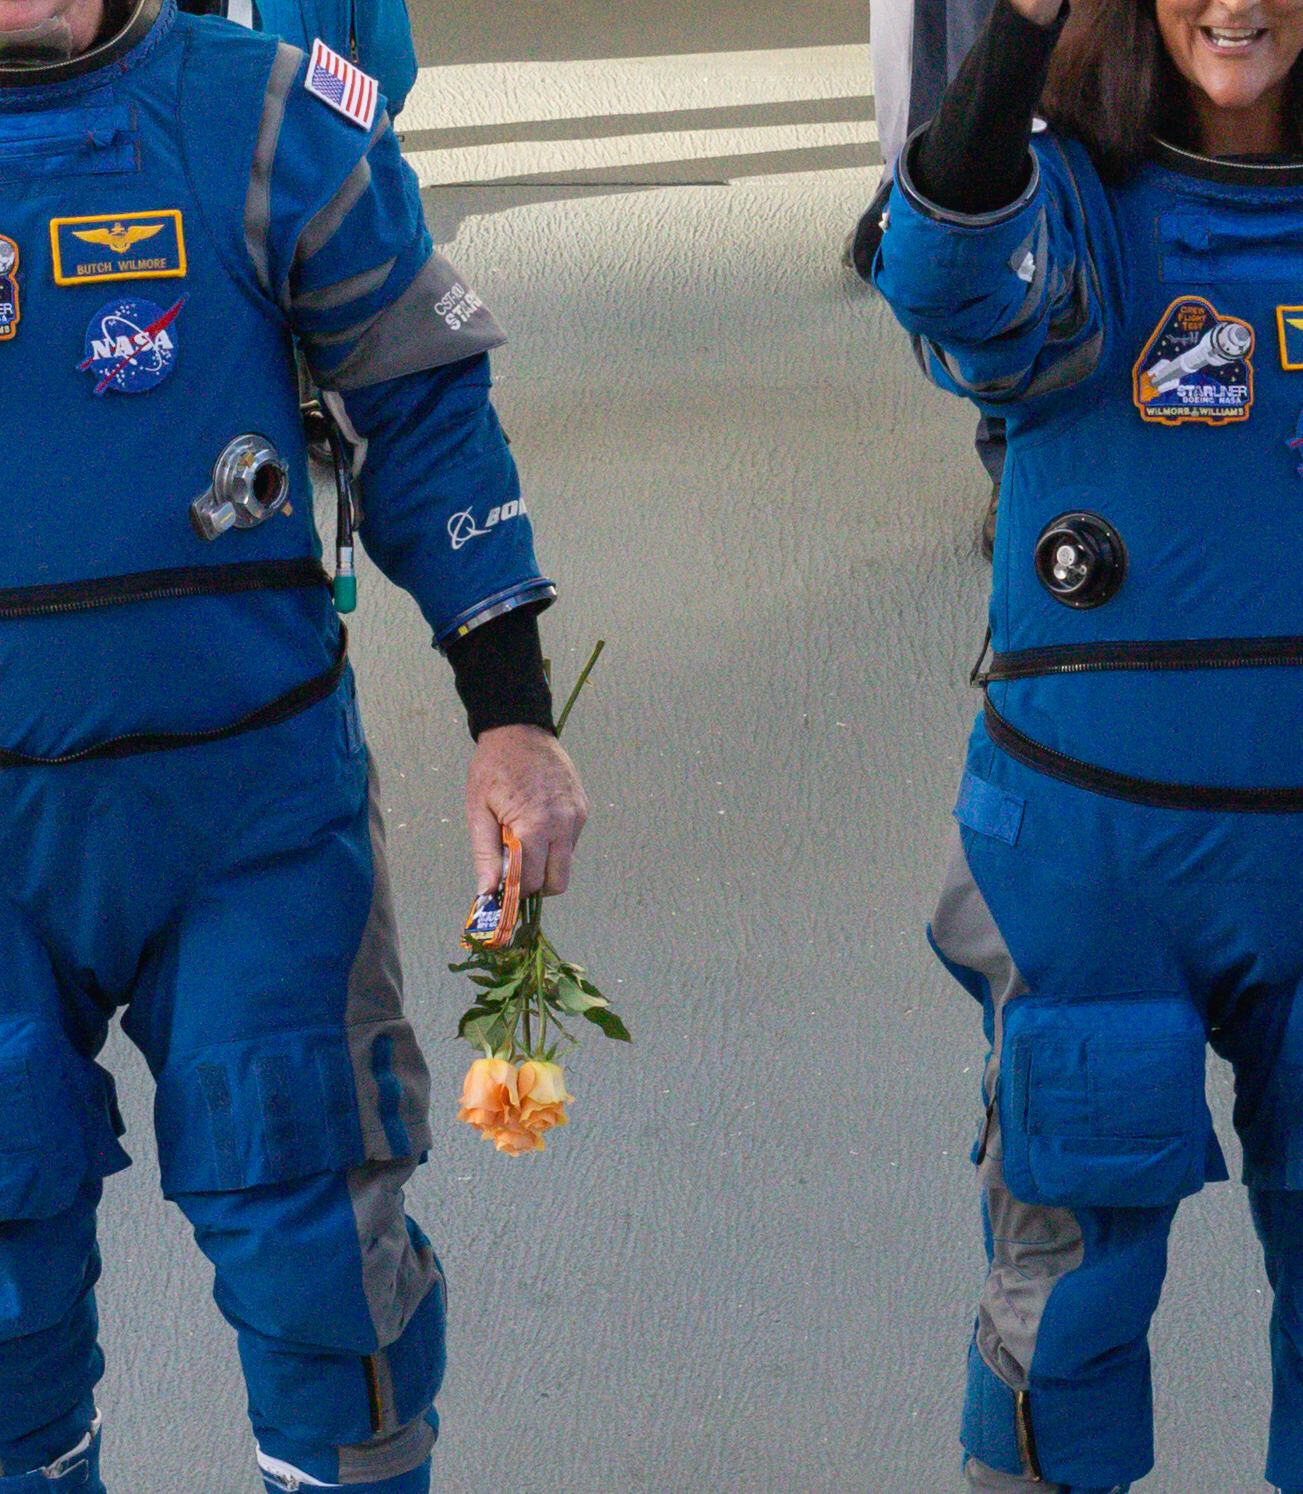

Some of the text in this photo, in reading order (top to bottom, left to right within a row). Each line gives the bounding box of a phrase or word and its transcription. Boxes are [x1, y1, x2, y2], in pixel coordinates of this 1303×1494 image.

[76, 258, 167, 275] BUTCH WILMORE
[1182, 322, 1203, 331] TEST
[91, 329, 174, 360] NASA
[1176, 385, 1248, 398] STARLINER
[1183, 396, 1242, 404] BOEING NASA
[1146, 407, 1244, 416] WILMORE WILLIAMS
